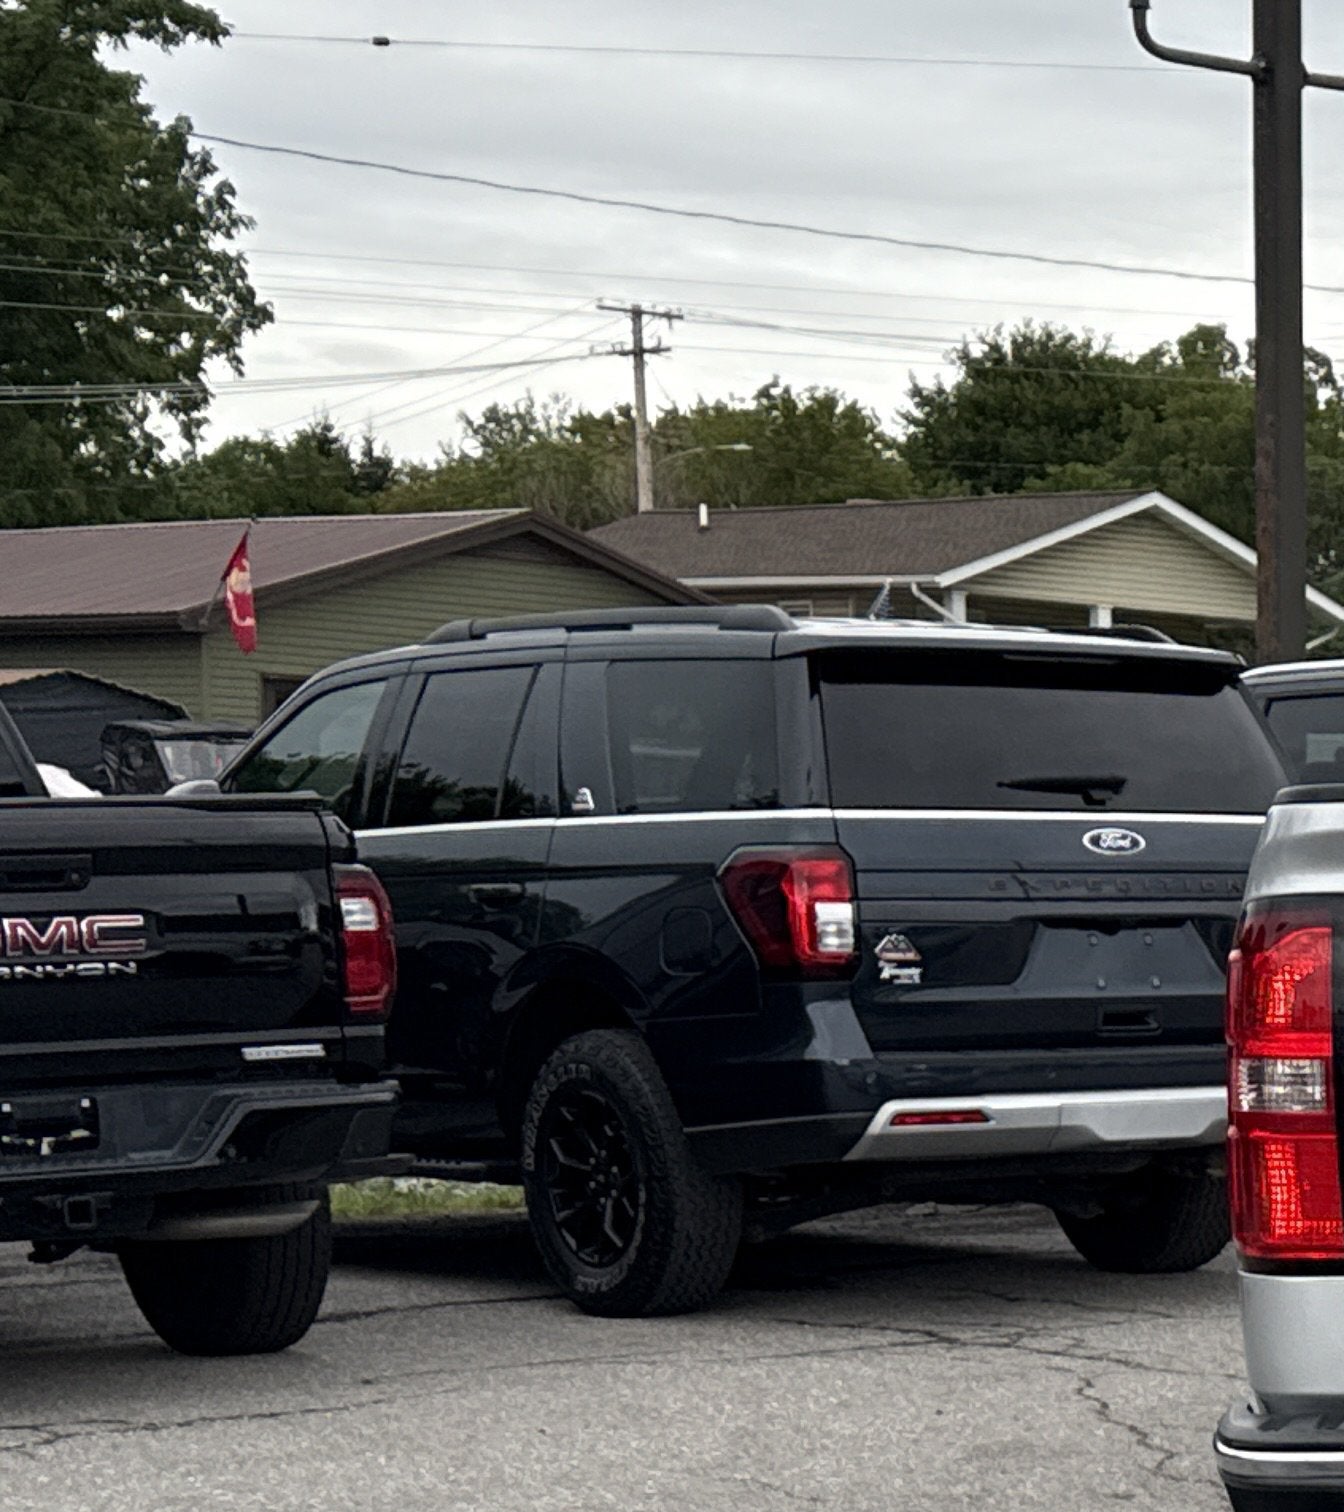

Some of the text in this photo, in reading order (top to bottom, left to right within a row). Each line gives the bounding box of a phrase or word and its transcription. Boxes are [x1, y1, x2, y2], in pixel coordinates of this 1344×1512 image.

[1098, 832, 1132, 849] Ford
[987, 875, 1246, 895] EXPEDITION
[0, 914, 147, 957] MC
